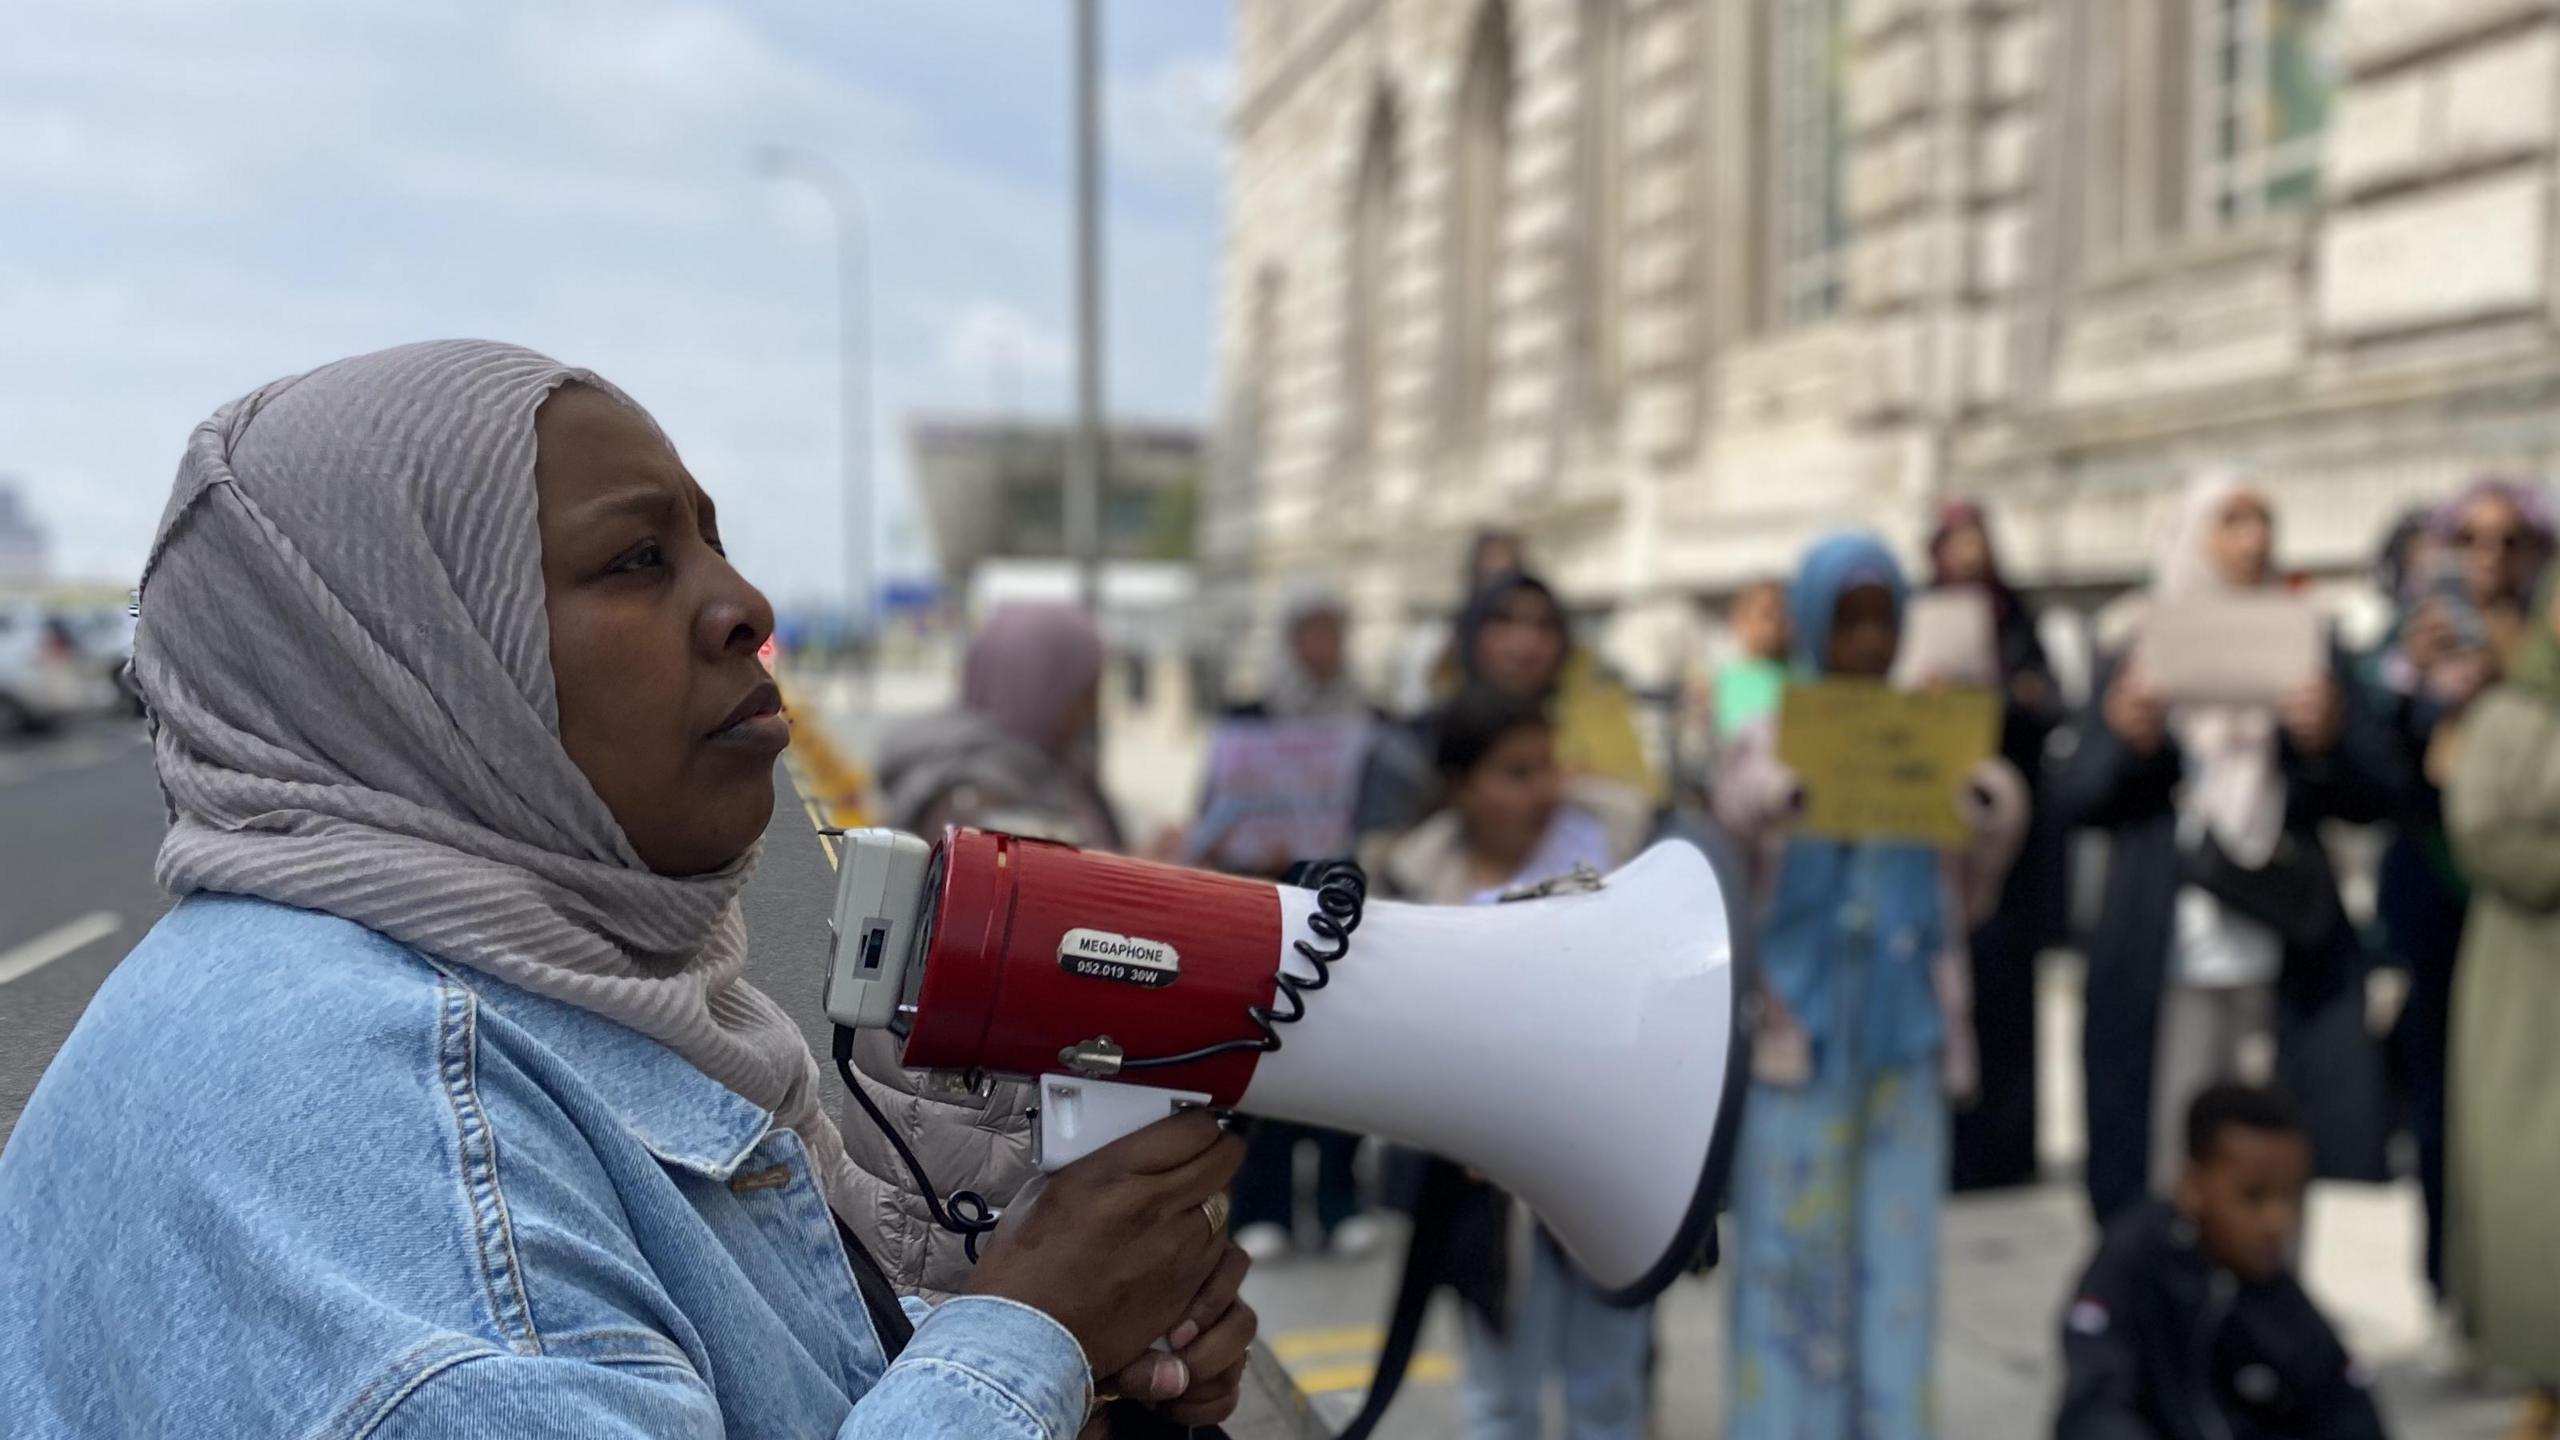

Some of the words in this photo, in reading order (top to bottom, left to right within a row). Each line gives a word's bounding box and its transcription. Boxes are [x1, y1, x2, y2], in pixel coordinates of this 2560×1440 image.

[1079, 938, 1163, 962] MEGAPHONE
[1077, 961, 1125, 978] 952.019
[1130, 969, 1158, 983] 30W
